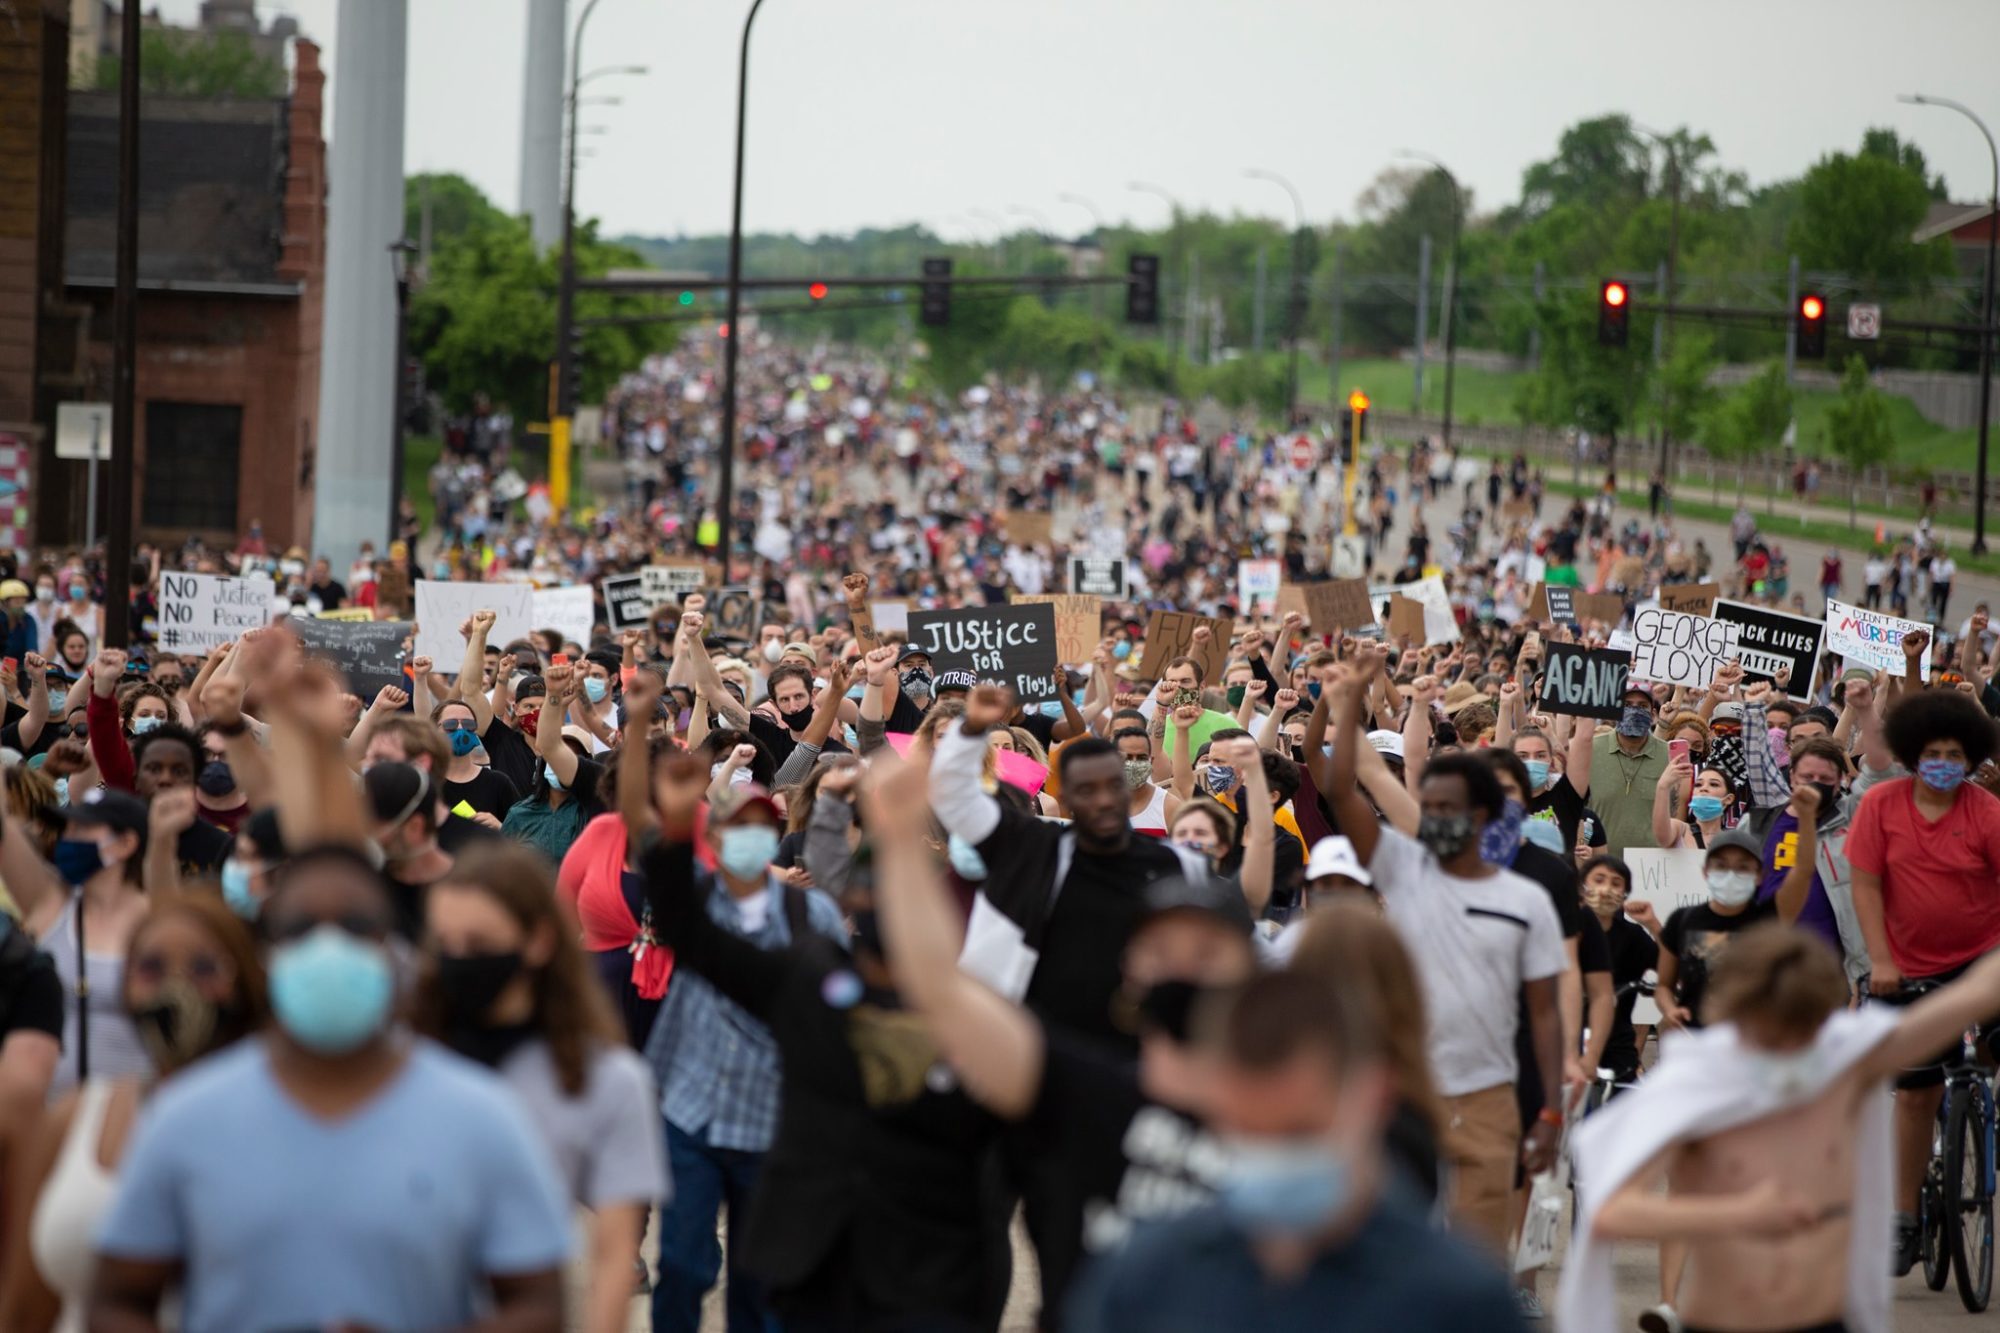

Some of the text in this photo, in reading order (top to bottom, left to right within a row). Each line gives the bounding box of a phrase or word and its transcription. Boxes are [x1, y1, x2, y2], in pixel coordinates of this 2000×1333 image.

[164, 576, 267, 607] NO Justice
[164, 602, 192, 624] NO
[1829, 601, 1841, 614] I
[1853, 608, 1892, 626] DIDN'T
[1634, 609, 1736, 661] GEORGE
[1771, 629, 1814, 653] LIVES
[1017, 674, 1056, 696] Floyd
[1542, 653, 1630, 709] AGAIN?
